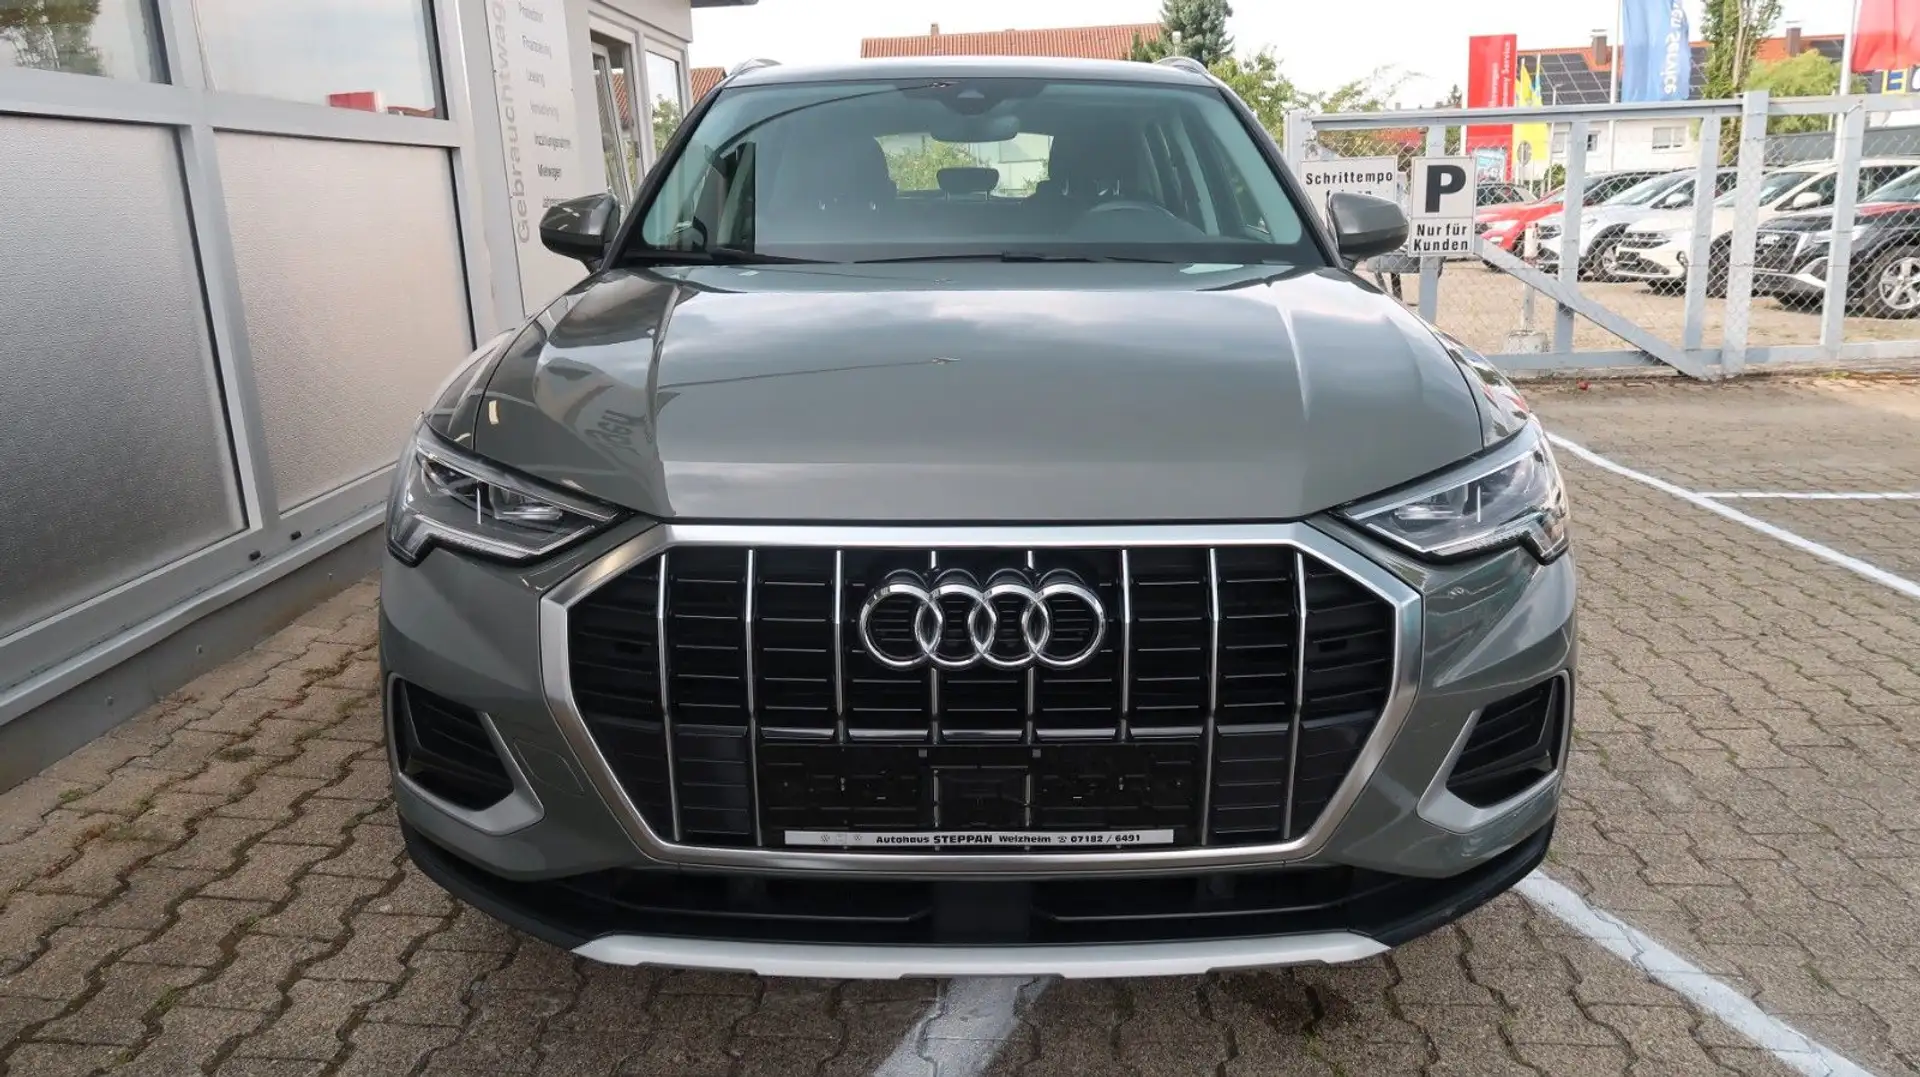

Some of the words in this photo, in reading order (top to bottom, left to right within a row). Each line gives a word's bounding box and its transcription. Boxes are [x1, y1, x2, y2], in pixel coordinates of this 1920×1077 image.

[1305, 171, 1394, 186] Schrittempo
[1424, 164, 1467, 213] P
[1416, 224, 1441, 236] Nur
[1445, 223, 1468, 235] für
[1413, 239, 1469, 251] Kunden
[876, 834, 930, 844] Autohaus
[933, 834, 993, 844] STEPPAN
[1070, 835, 1104, 844] 07182
[1114, 834, 1141, 843] 6491
